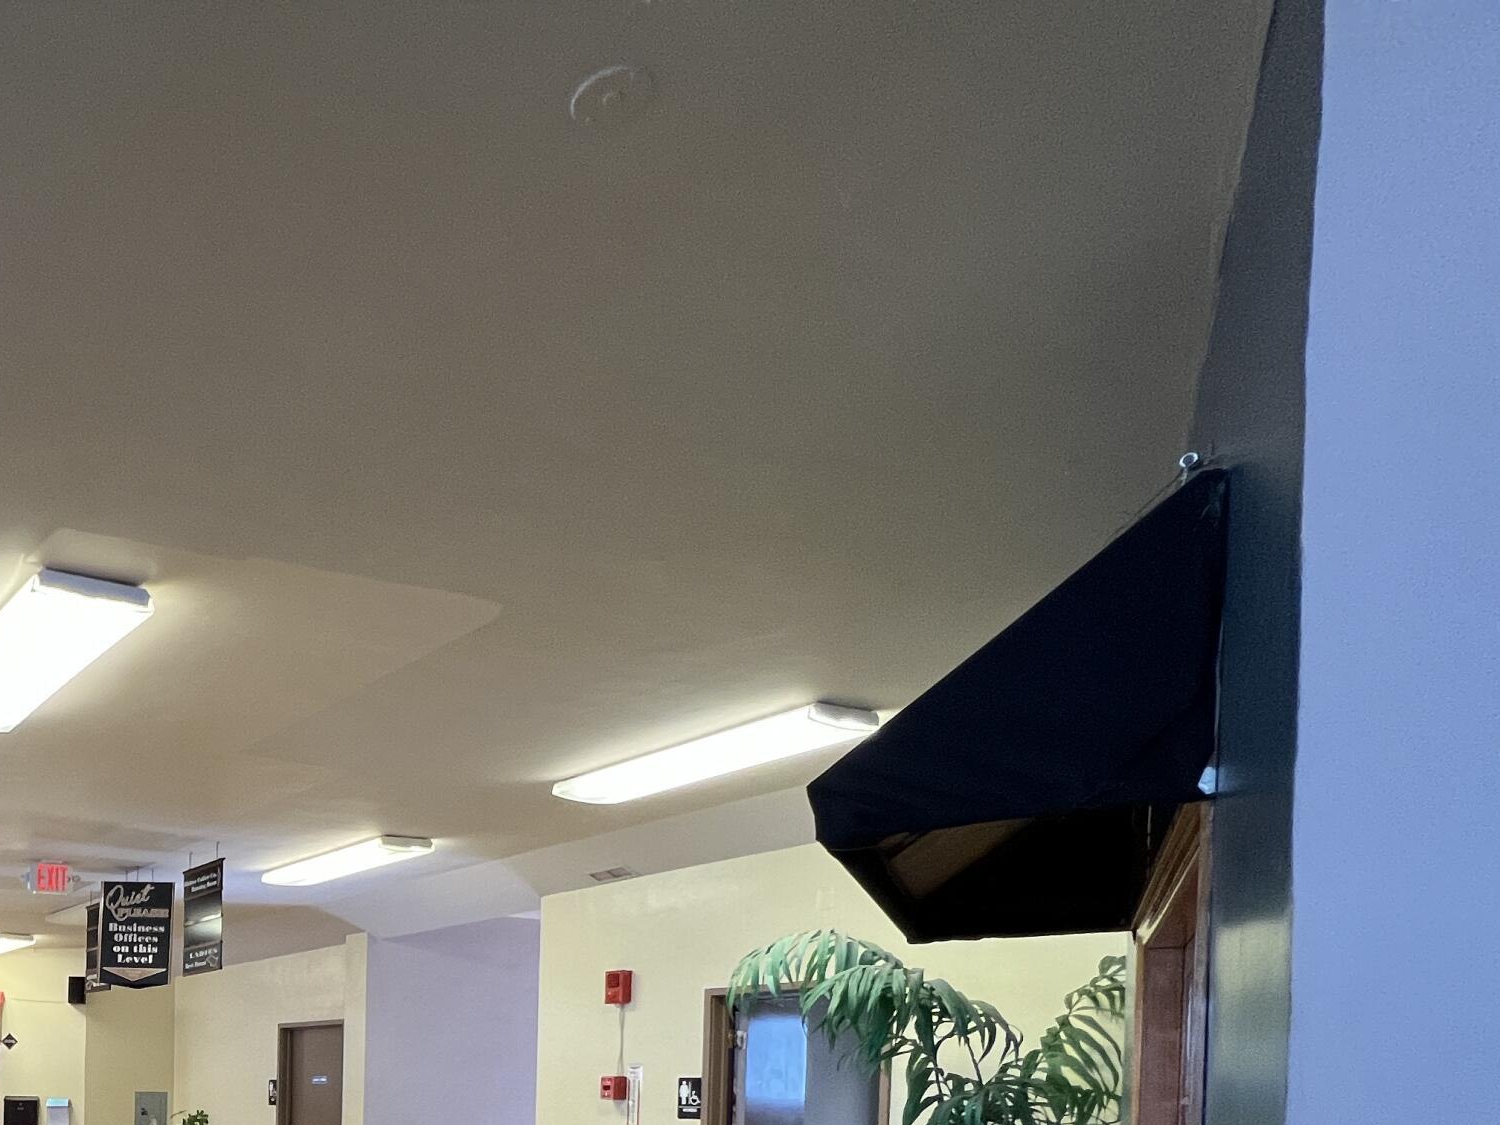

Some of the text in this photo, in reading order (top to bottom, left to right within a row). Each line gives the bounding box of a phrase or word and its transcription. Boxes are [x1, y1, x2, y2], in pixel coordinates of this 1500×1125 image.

[37, 864, 68, 891] EXIT
[105, 884, 155, 922] Quiet
[108, 922, 165, 933] Business
[113, 933, 159, 943] Offices
[112, 943, 158, 954] on this
[117, 953, 154, 964] Level
